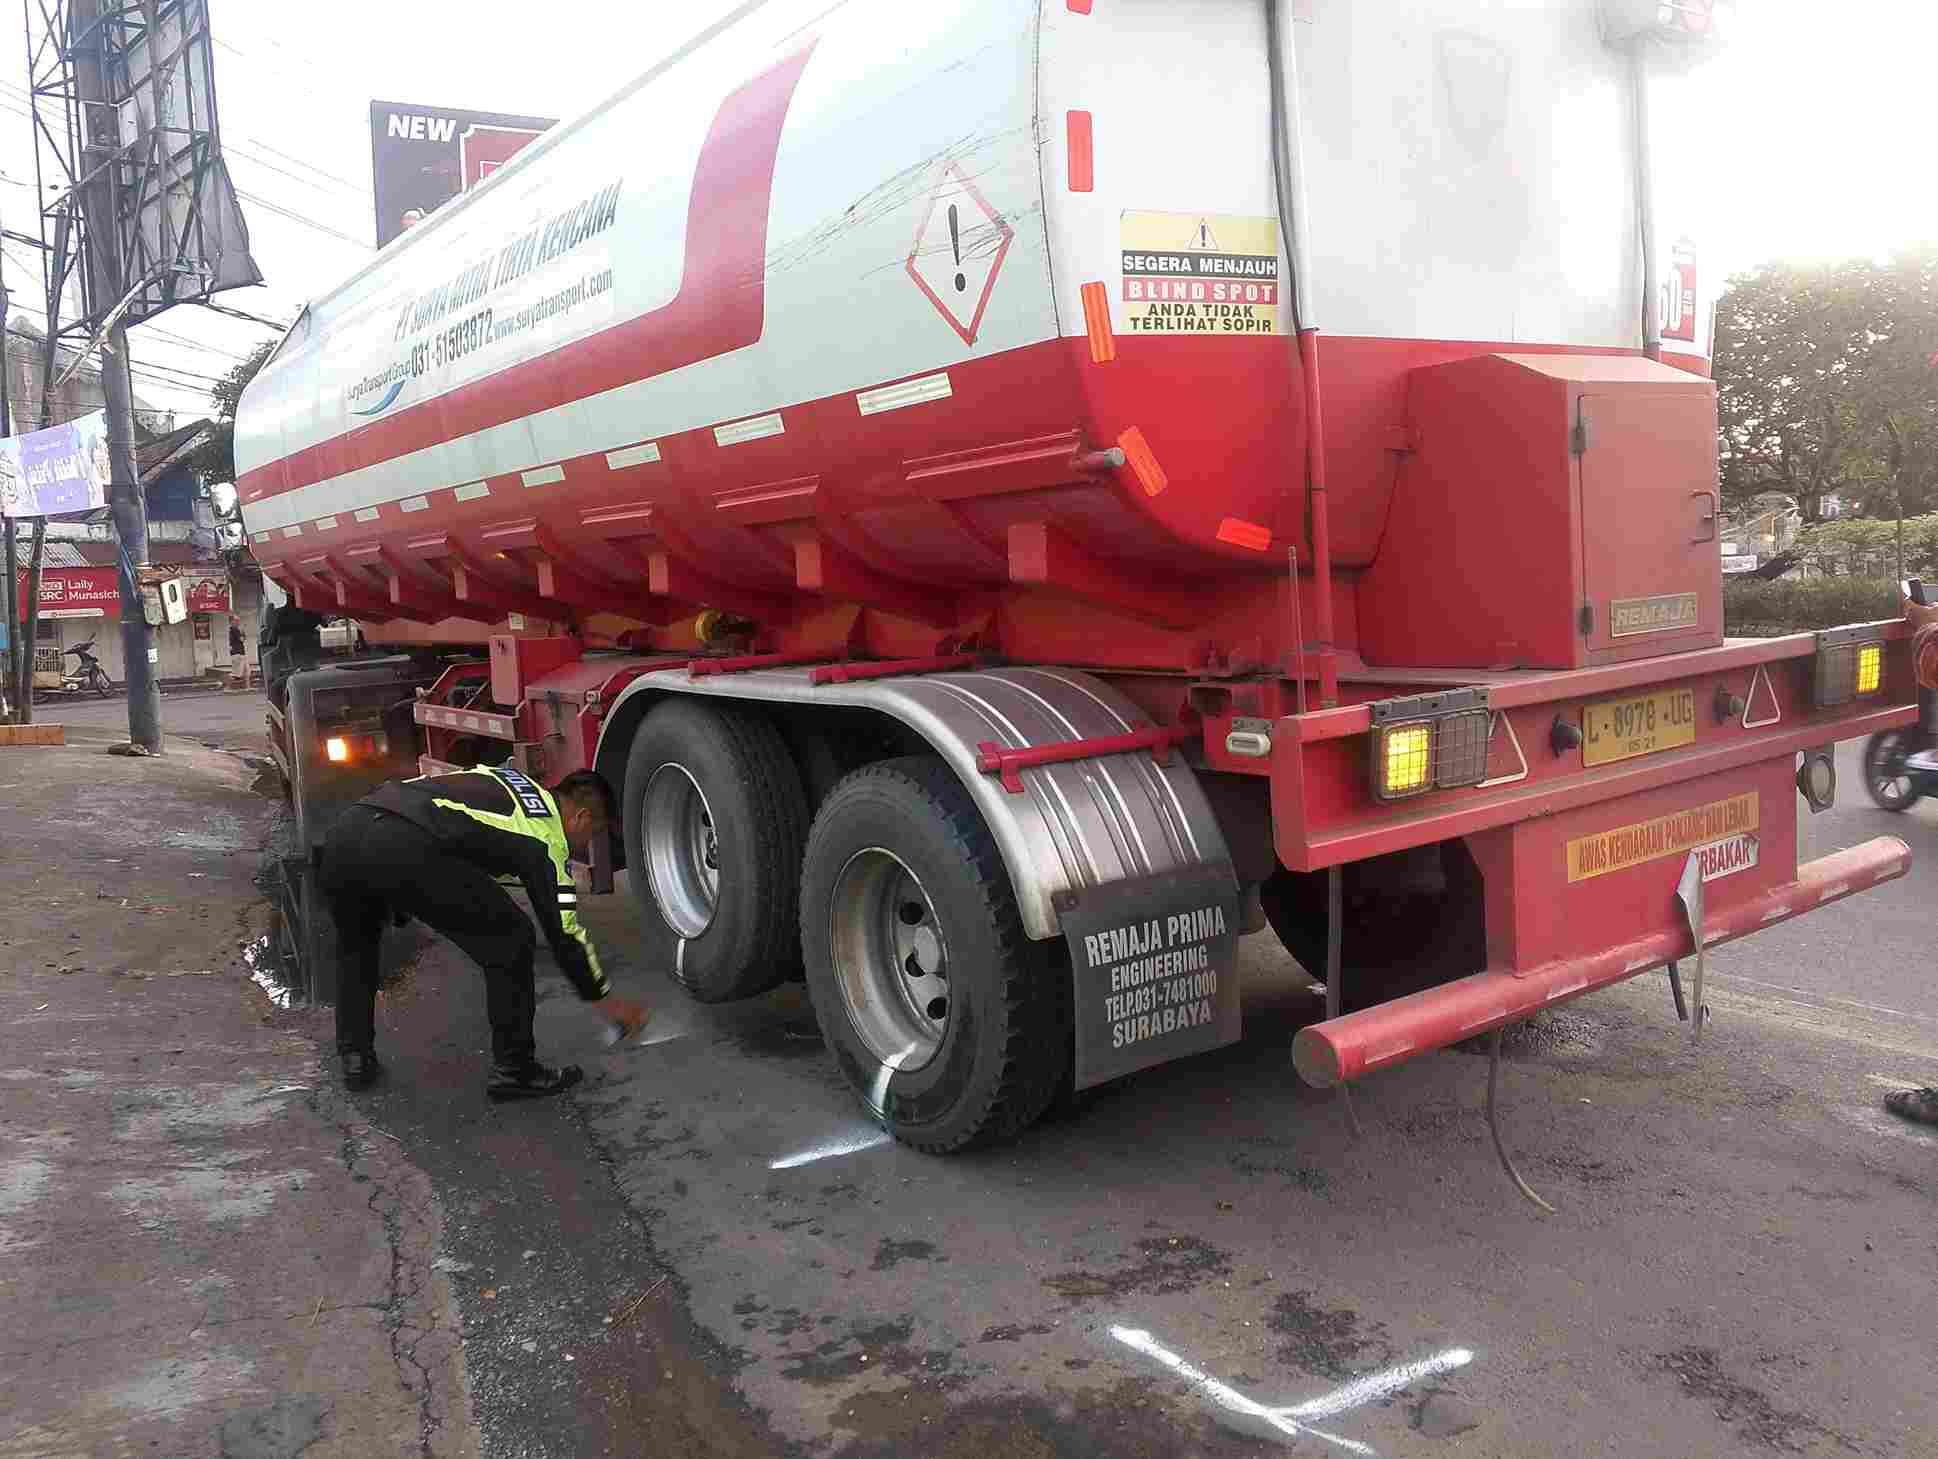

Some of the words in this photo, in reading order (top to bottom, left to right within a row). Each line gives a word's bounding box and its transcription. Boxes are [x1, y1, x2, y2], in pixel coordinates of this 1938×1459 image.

[387, 113, 457, 142] NEW
[1123, 255, 1192, 272] SEGERA
[1200, 258, 1277, 275] MENJAUH
[1128, 281, 1205, 300] BLIND
[1213, 283, 1273, 301] SPOT
[1129, 317, 1217, 331] TERLIHAT
[1222, 319, 1272, 332] SOPIR
[1147, 303, 1197, 317] ANDA
[1202, 304, 1254, 318] TIDAK
[39, 591, 64, 601] SRC
[1587, 718, 1601, 744] L
[1671, 692, 1693, 725] UG
[497, 768, 548, 814] POLISI
[1579, 838, 1607, 873] AWAS
[1084, 919, 1163, 968] REMAJA
[1167, 905, 1226, 946] PRIMA
[1111, 944, 1209, 992] ENGINEERING
[1112, 1000, 1213, 1049] SURABAYA
